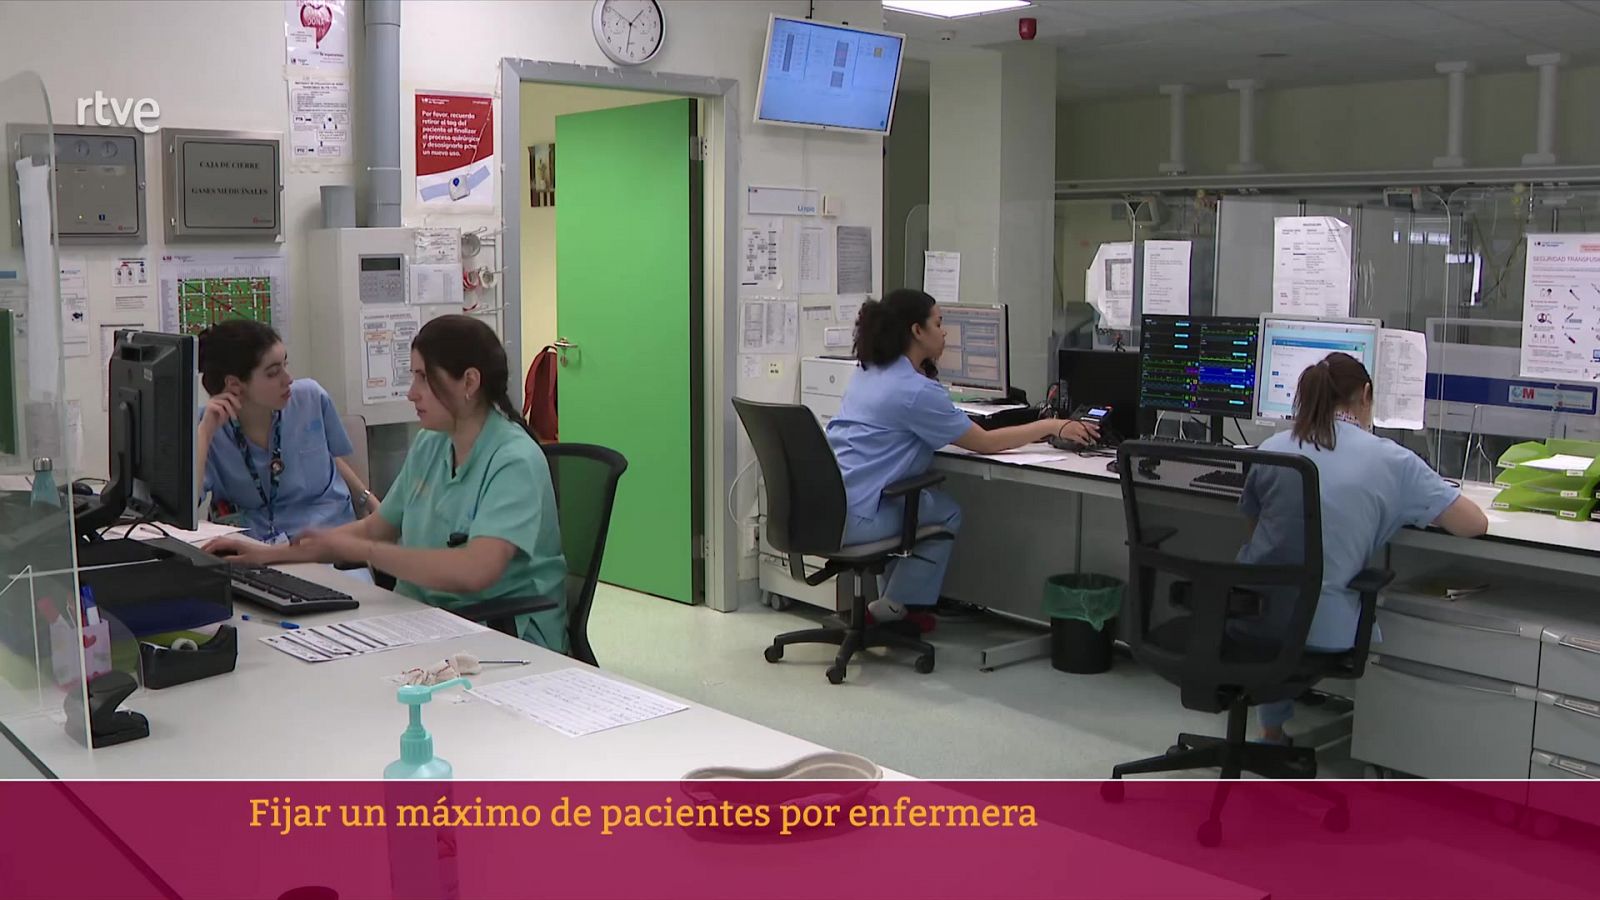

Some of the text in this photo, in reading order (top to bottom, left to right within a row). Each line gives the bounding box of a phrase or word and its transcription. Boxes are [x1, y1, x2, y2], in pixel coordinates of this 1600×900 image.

[422, 126, 446, 134] paciente
[428, 135, 451, 143] proceso
[217, 187, 268, 195] MEDICINALES
